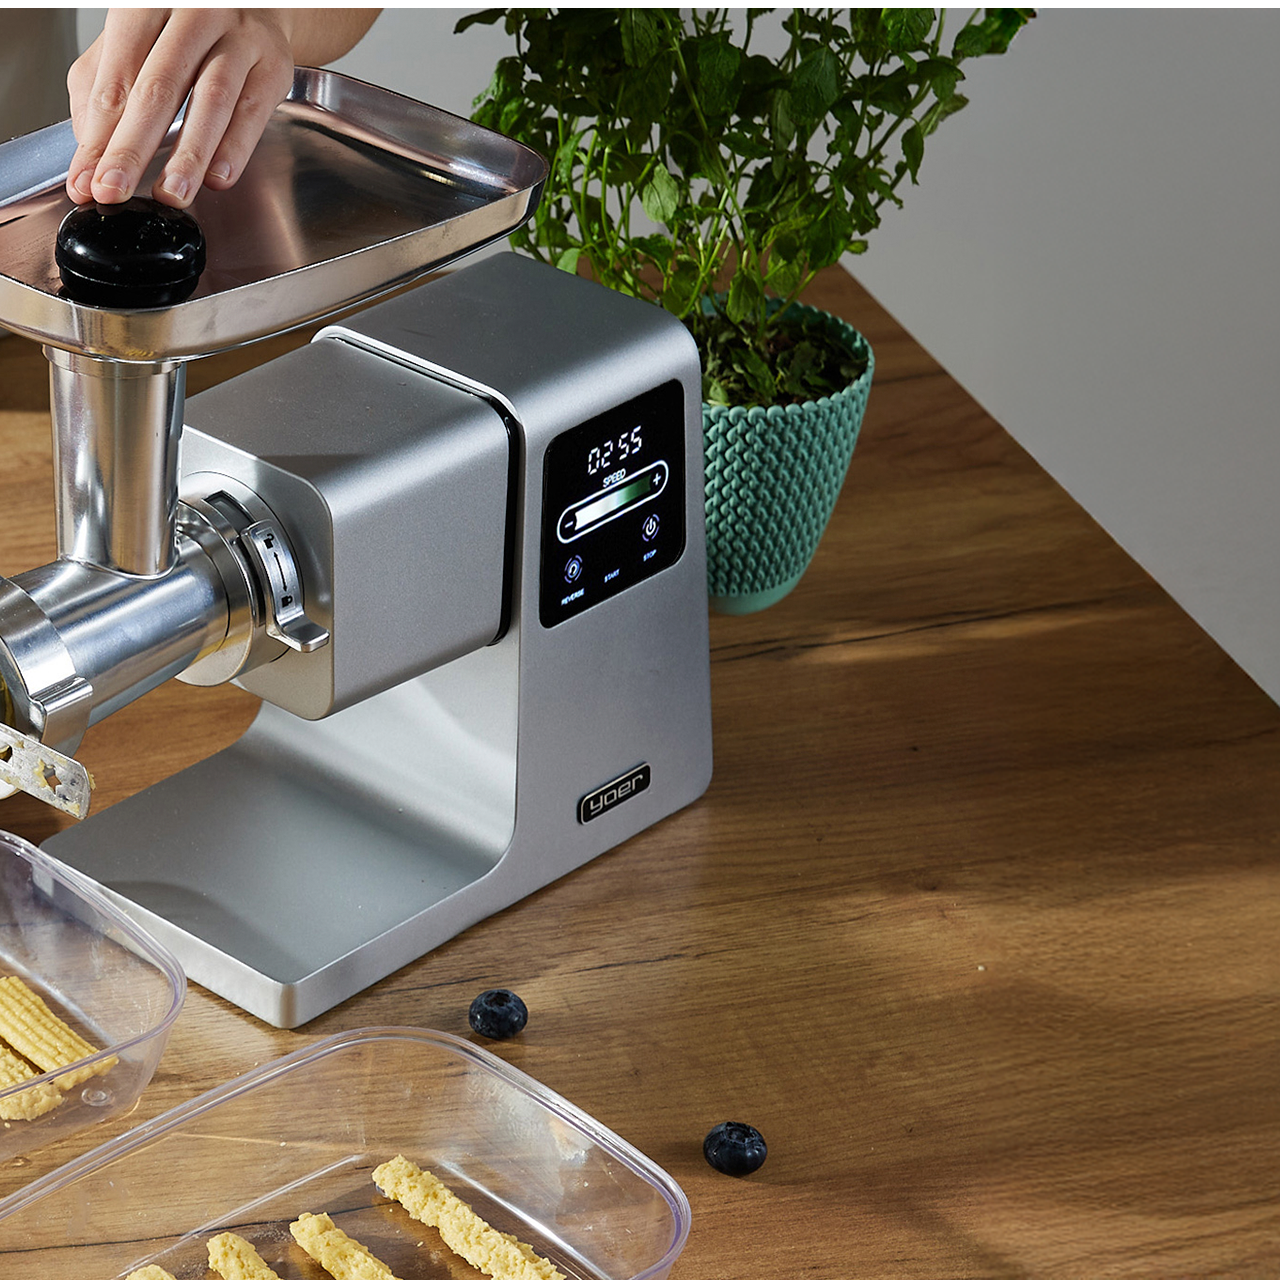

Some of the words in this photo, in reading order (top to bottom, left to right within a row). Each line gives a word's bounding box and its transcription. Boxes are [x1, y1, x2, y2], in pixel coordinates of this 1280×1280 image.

[602, 468, 626, 488] SPEED
[643, 549, 656, 561] STOP
[604, 569, 619, 582] START
[561, 588, 585, 606] REVERSE
[589, 774, 644, 816] yoer
